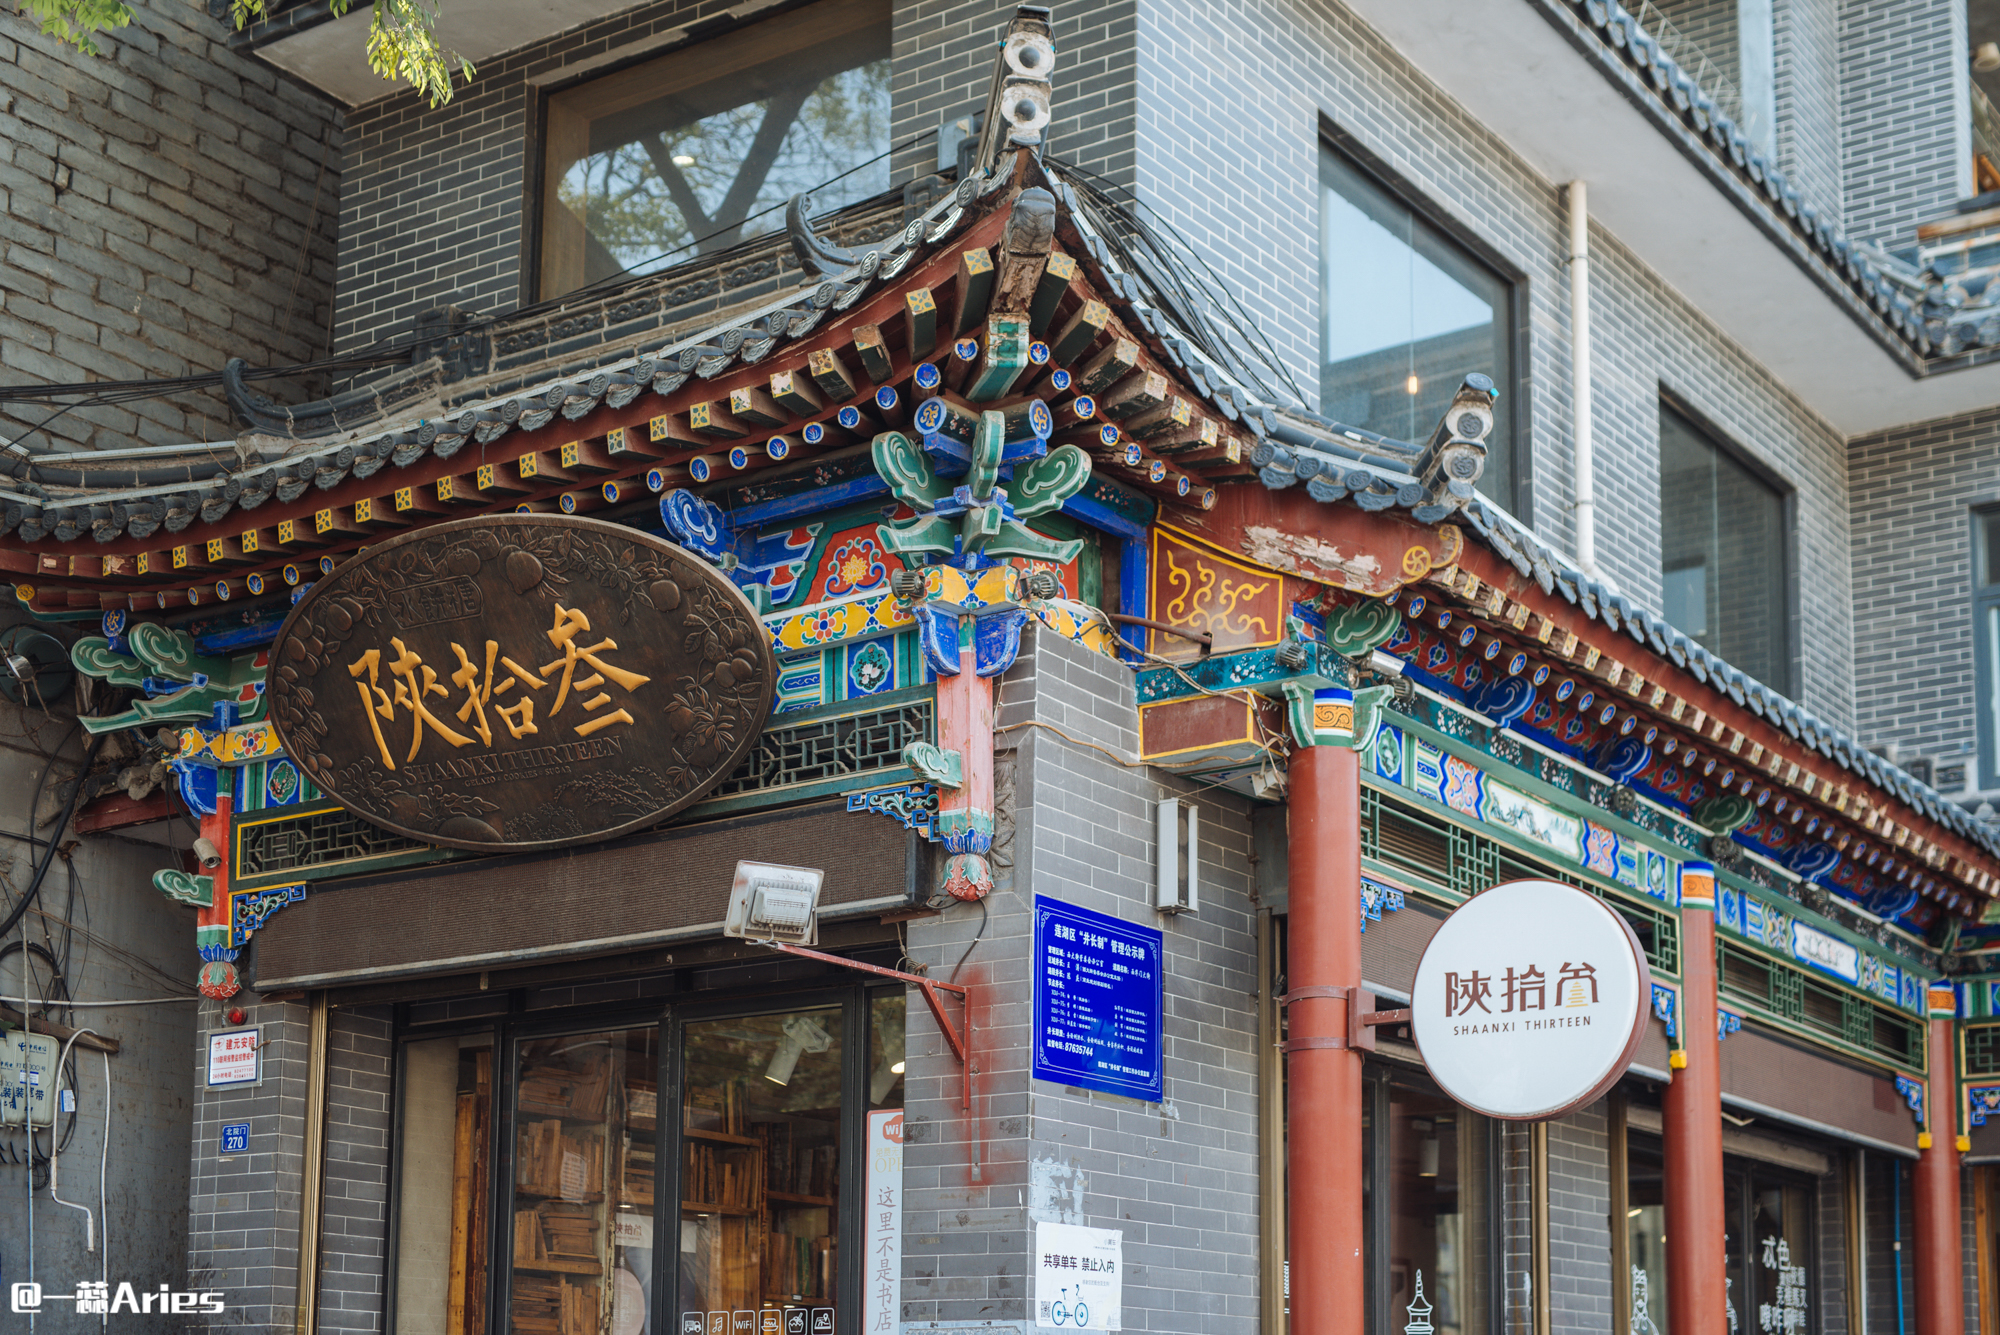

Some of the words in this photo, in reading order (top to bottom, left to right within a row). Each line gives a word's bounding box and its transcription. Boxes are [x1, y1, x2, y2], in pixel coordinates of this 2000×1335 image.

[402, 753, 503, 786] SHAANXI
[502, 735, 624, 770] THIRTEEN
[464, 776, 496, 787] GELATO
[503, 769, 538, 781] COOKIES
[545, 765, 572, 776] SUGAR
[1453, 1022, 1515, 1036] SHAANXI
[1525, 1015, 1591, 1030] THIRTEEN
[226, 1035, 255, 1050] 建元安防
[226, 1127, 246, 1136] 北院门
[227, 1136, 244, 1149] 270
[874, 1186, 897, 1332] 这里不是书店
[1043, 1253, 1077, 1271] 共享单车
[1081, 1256, 1115, 1274] 禁止入内
[735, 1319, 752, 1330] WiFi
